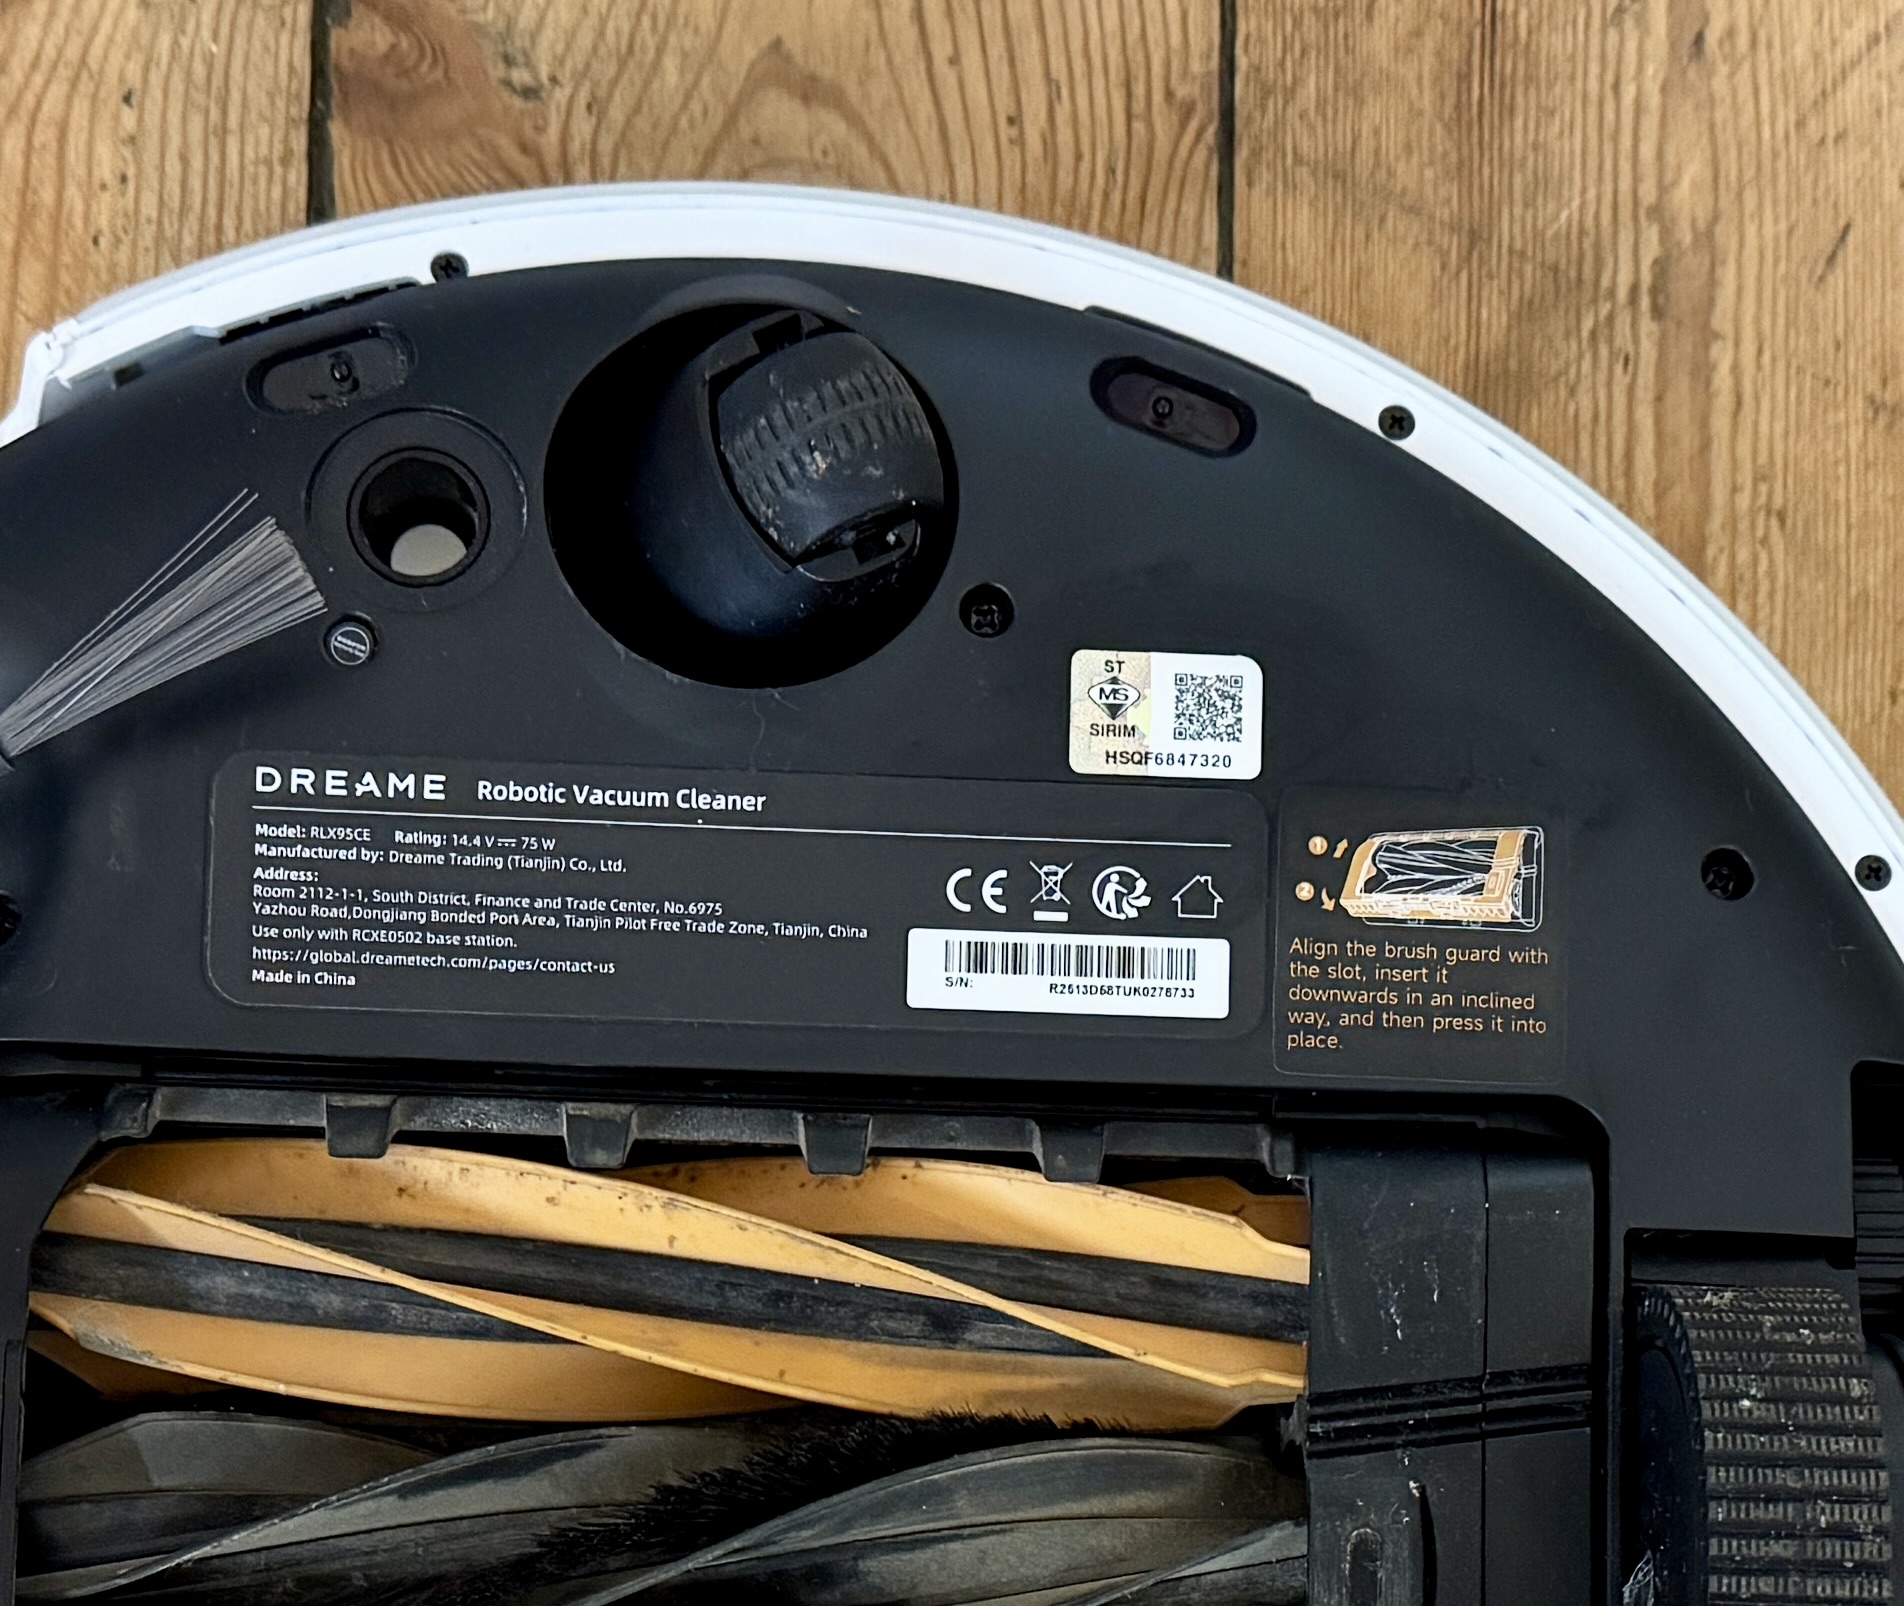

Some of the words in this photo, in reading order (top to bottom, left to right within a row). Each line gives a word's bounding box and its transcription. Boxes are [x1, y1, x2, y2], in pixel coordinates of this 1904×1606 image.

[1104, 659, 1125, 674] ST
[1099, 686, 1129, 702] MS
[1089, 723, 1136, 738] SIRIM
[1105, 750, 1232, 768] HSQF6847320
[255, 765, 446, 800] DREAME
[477, 780, 567, 804] Robotic
[573, 784, 670, 808] Vacuum
[676, 788, 767, 812] Cleaner
[255, 823, 306, 839] Model:
[394, 830, 447, 848] Rating:
[451, 833, 482, 848] 14.4
[485, 835, 495, 848] V
[521, 836, 539, 850] 75
[542, 838, 556, 850] W
[254, 844, 357, 862] Manufactured
[361, 850, 384, 866] by:
[389, 850, 445, 865] Dreame
[449, 853, 503, 870] Trading
[507, 855, 566, 872] (Tianjin)
[569, 858, 596, 873] Co.,
[600, 859, 627, 873] Ltd.
[253, 867, 319, 882] Address:
[253, 885, 295, 899] Room
[299, 887, 368, 902] 2112-1-1,
[372, 889, 414, 904] South
[418, 891, 471, 907] District,
[475, 893, 530, 908] Finance
[534, 896, 562, 909] and
[566, 897, 606, 912] Trade
[610, 898, 660, 915] Center,
[664, 900, 723, 915] No.6975
[253, 902, 307, 918] Yazhou
[310, 904, 427, 924] Road,Dongjiang
[431, 910, 486, 925] Bonded
[490, 911, 519, 925] Port
[522, 913, 560, 929] Area,
[564, 914, 611, 931] Tianjin
[615, 916, 647, 930] Pilot
[650, 918, 681, 932] Free
[684, 919, 725, 934] Trade
[729, 921, 769, 937] Zone,
[773, 922, 824, 940] Tianjin,
[828, 924, 868, 939] China
[252, 925, 279, 938] Use
[282, 927, 314, 943] only
[317, 927, 348, 941] with
[352, 930, 423, 945] RCXE0502
[426, 932, 462, 946] base
[464, 934, 518, 949] station.
[252, 947, 616, 973] https://global.dreametech.com/pages/contact-us
[1289, 938, 1338, 960] Align
[1346, 941, 1377, 957] the
[1385, 941, 1437, 959] brush
[1446, 947, 1501, 966] guard
[1508, 948, 1549, 965] with
[251, 970, 293, 984] Made
[296, 971, 311, 984] in
[314, 972, 356, 986] China
[945, 977, 973, 988] S/N:
[1289, 962, 1320, 979] the
[1327, 963, 1367, 983] slot,
[1375, 964, 1429, 983] insert
[1436, 966, 1448, 984] it
[1288, 988, 1398, 1005] downwards
[1406, 988, 1423, 1005] in
[1430, 994, 1453, 1007] an
[1461, 992, 1535, 1010] inclined
[1287, 1011, 1331, 1029] way,
[1339, 1010, 1374, 1027] and
[1382, 1011, 1424, 1029] then
[1432, 1018, 1484, 1034] press
[1491, 1014, 1504, 1032] it
[1511, 1016, 1547, 1034] into
[1286, 1032, 1343, 1050] place.
